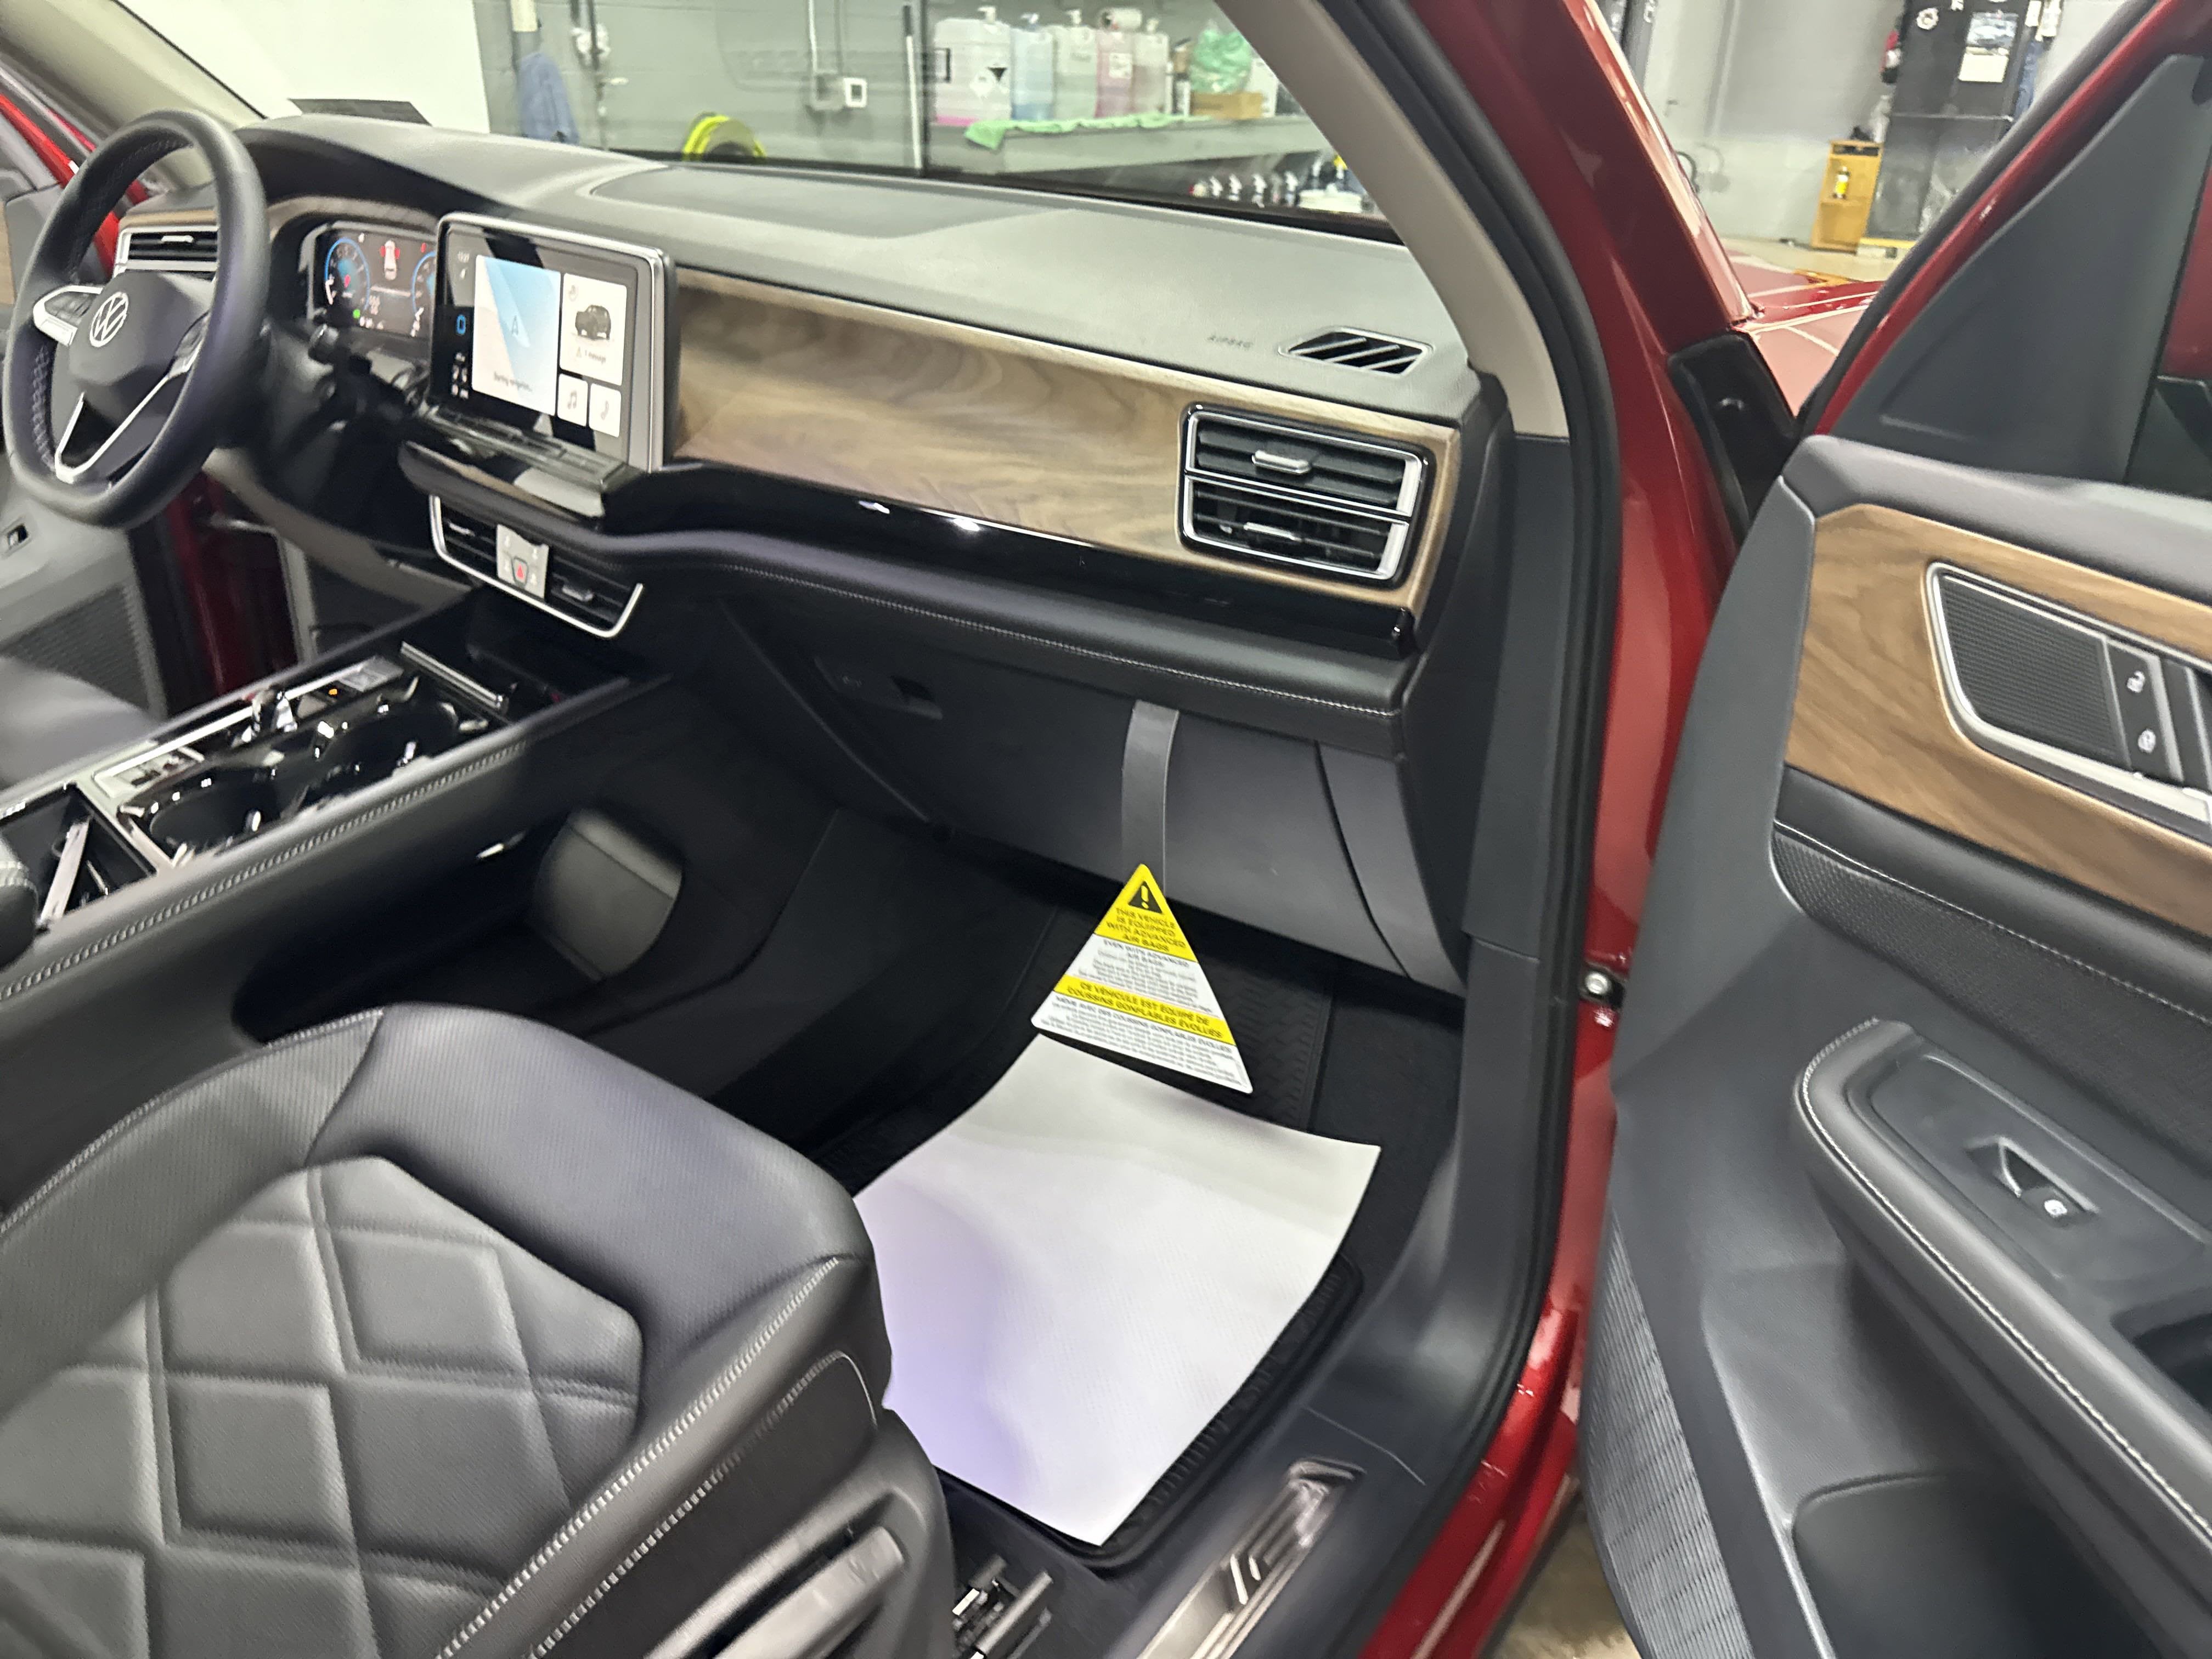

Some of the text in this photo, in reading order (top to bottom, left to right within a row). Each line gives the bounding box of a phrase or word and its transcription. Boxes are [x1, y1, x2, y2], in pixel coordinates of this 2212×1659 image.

[1116, 907, 1175, 929] THIS VEHICLE
[1116, 915, 1175, 936] IS EQUIPPED
[1106, 920, 1186, 948] WITH ADVANCED
[1122, 933, 1169, 951] AIR BAGS
[1067, 987, 1113, 1005] COUSSINS
[1116, 1001, 1176, 1024] GONFLABLES
